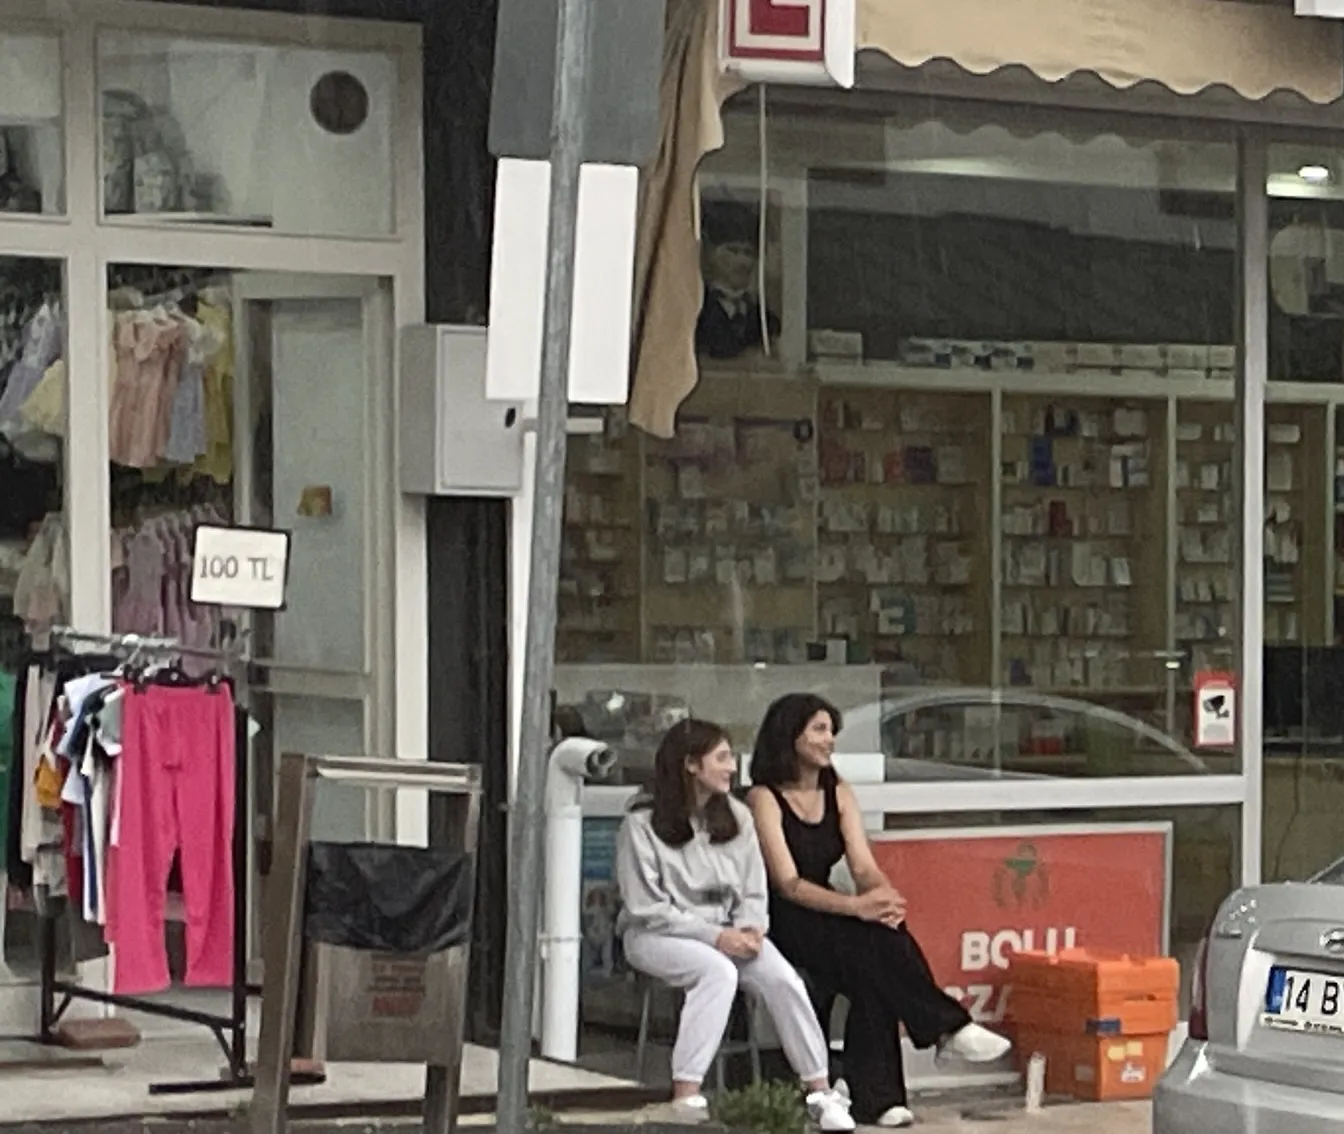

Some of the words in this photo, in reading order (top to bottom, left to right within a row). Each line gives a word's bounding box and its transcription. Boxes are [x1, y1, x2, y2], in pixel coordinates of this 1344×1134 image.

[200, 553, 239, 579] 100
[247, 556, 274, 582] TL
[1285, 976, 1311, 1013] 14
